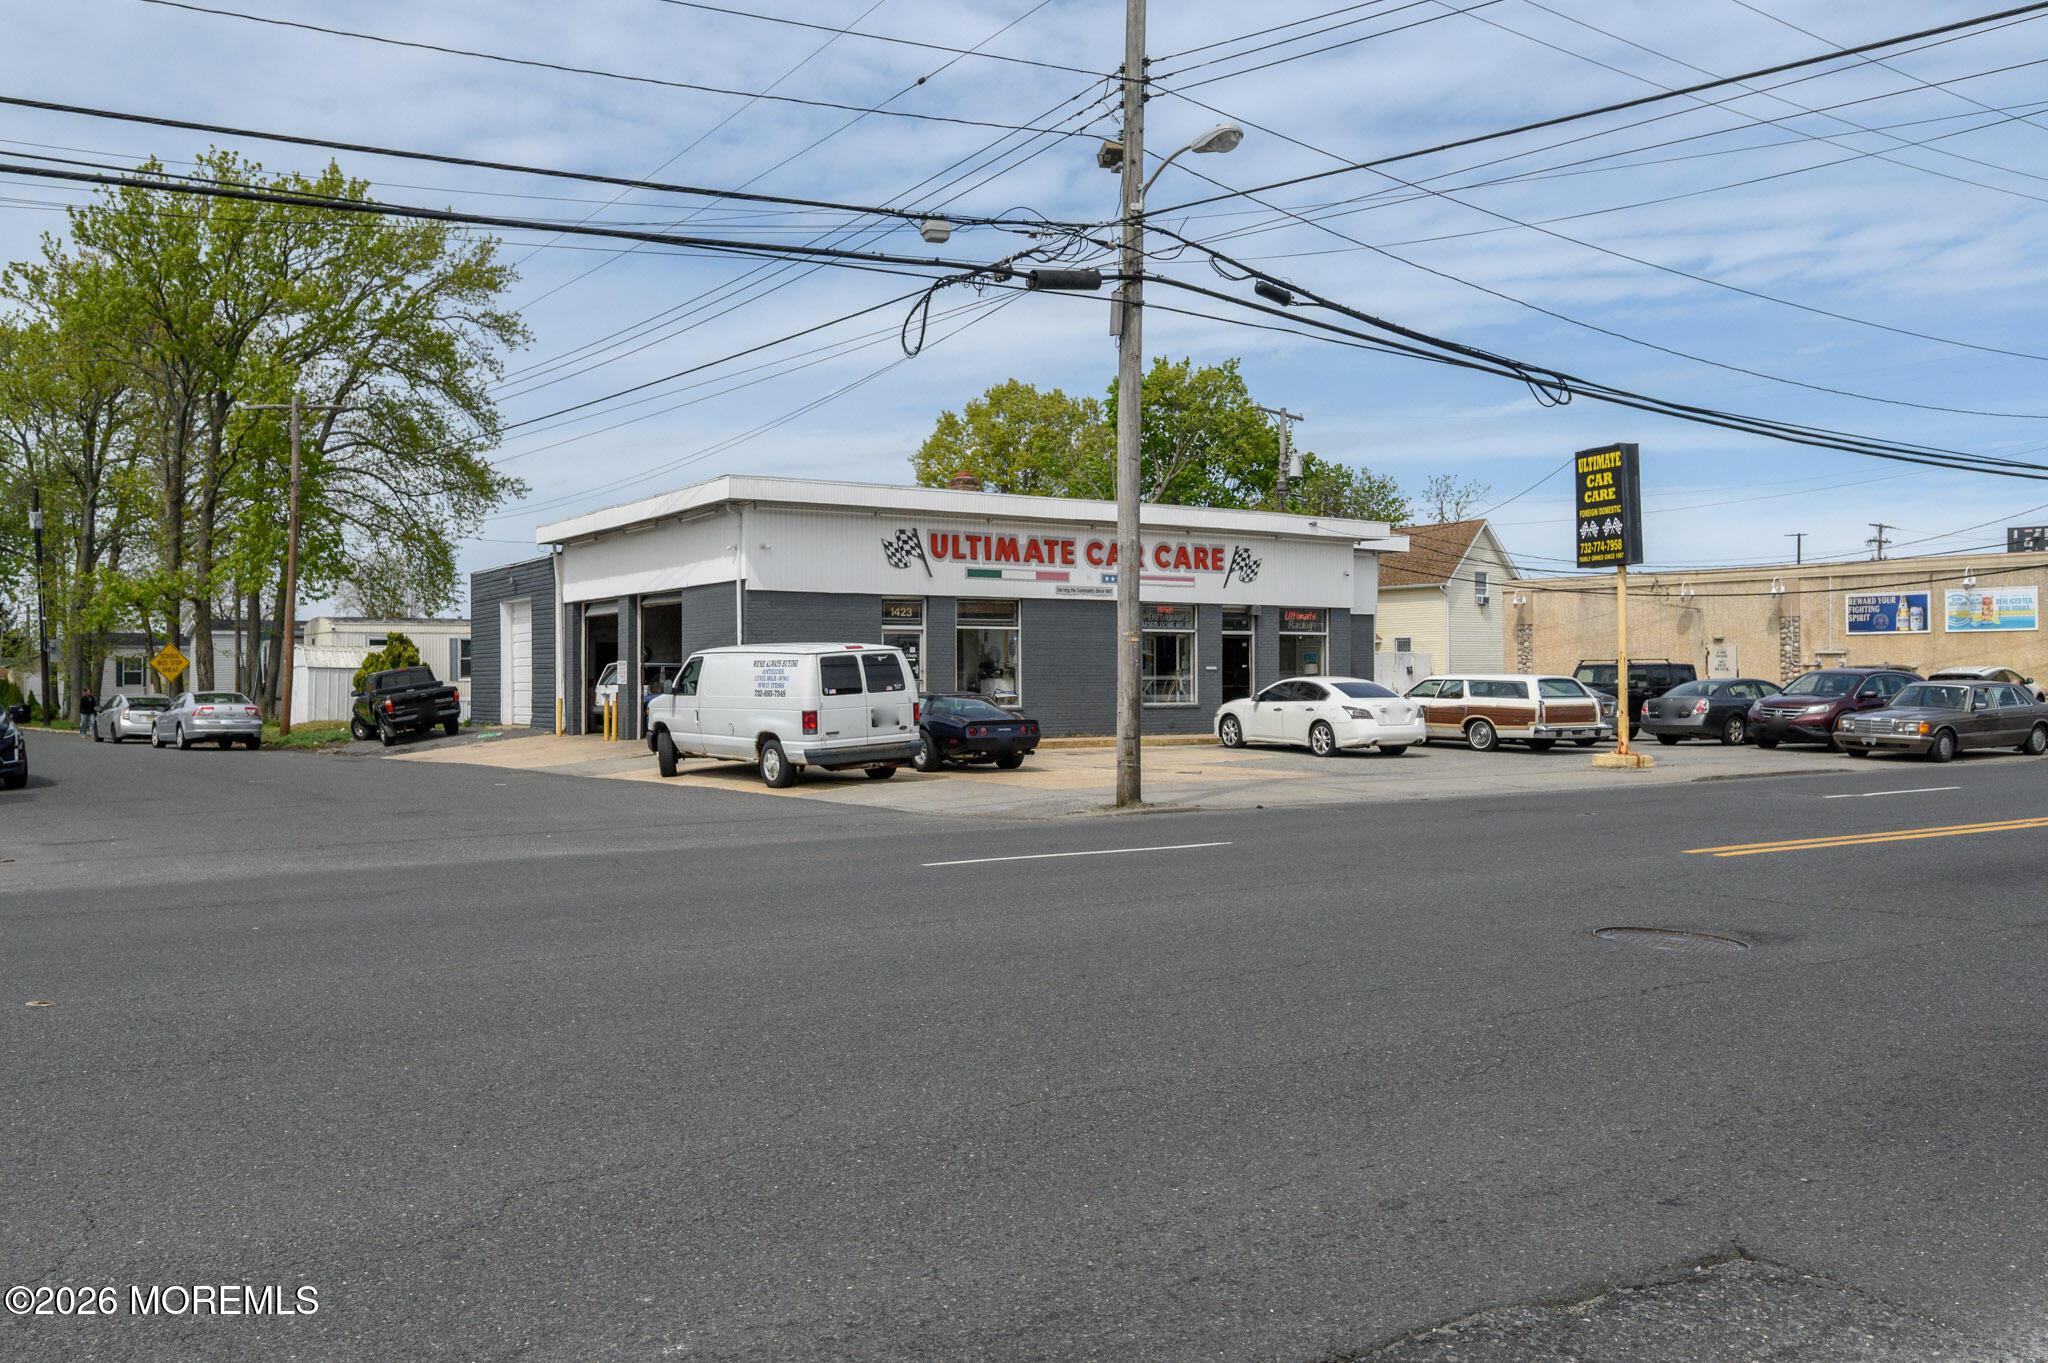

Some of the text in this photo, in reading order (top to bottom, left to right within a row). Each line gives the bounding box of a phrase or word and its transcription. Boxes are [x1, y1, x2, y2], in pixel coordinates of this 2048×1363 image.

[1578, 451, 1622, 473] ULTIMATE
[1586, 471, 1613, 488] CAR
[1584, 487, 1616, 503] CARE
[930, 533, 1075, 565] ULTIMATE
[1154, 545, 1225, 571] CARE
[1848, 595, 1896, 605] REWARD YOUR
[890, 607, 913, 617] 1423
[1848, 605, 1880, 614] FIGHTING
[1848, 614, 1871, 622] SPIRIT
